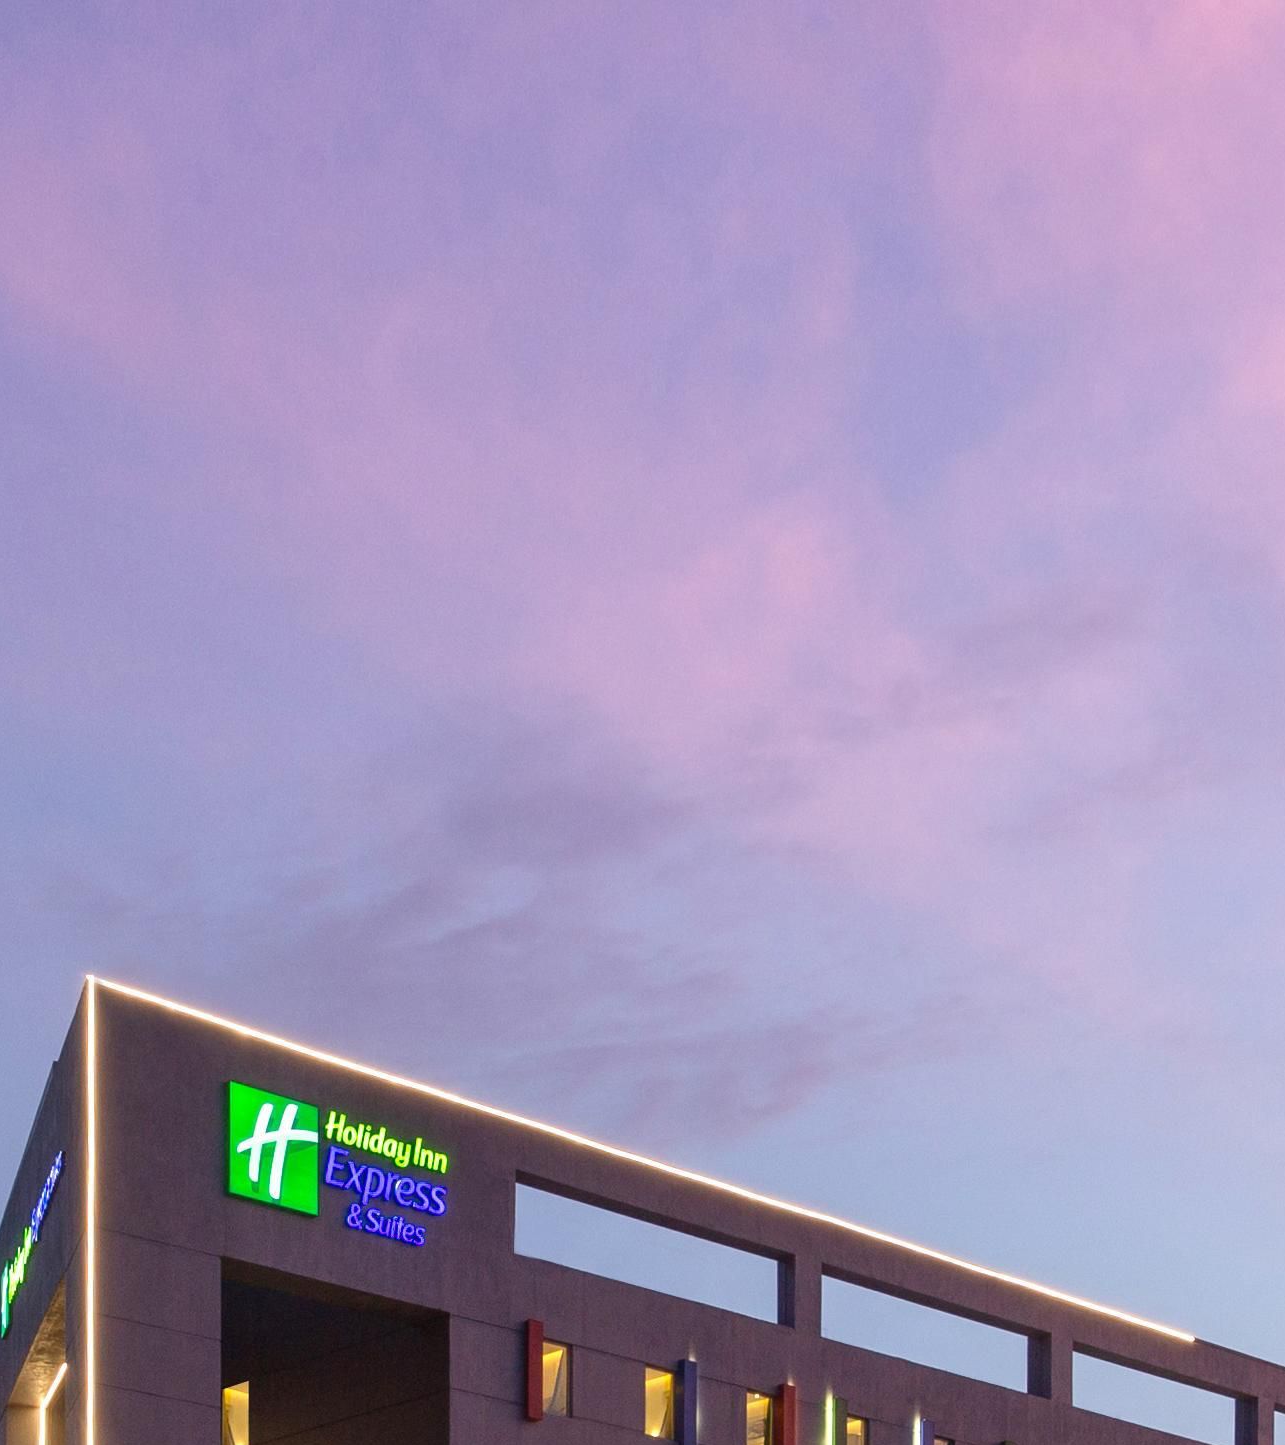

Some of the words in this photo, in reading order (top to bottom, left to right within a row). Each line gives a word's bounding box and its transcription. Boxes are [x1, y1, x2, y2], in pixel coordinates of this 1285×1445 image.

[325, 1111, 411, 1168] Holiday
[412, 1137, 448, 1174] Inn
[324, 1146, 448, 1216] Express
[346, 1203, 363, 1230] &
[365, 1208, 426, 1247] Suites
